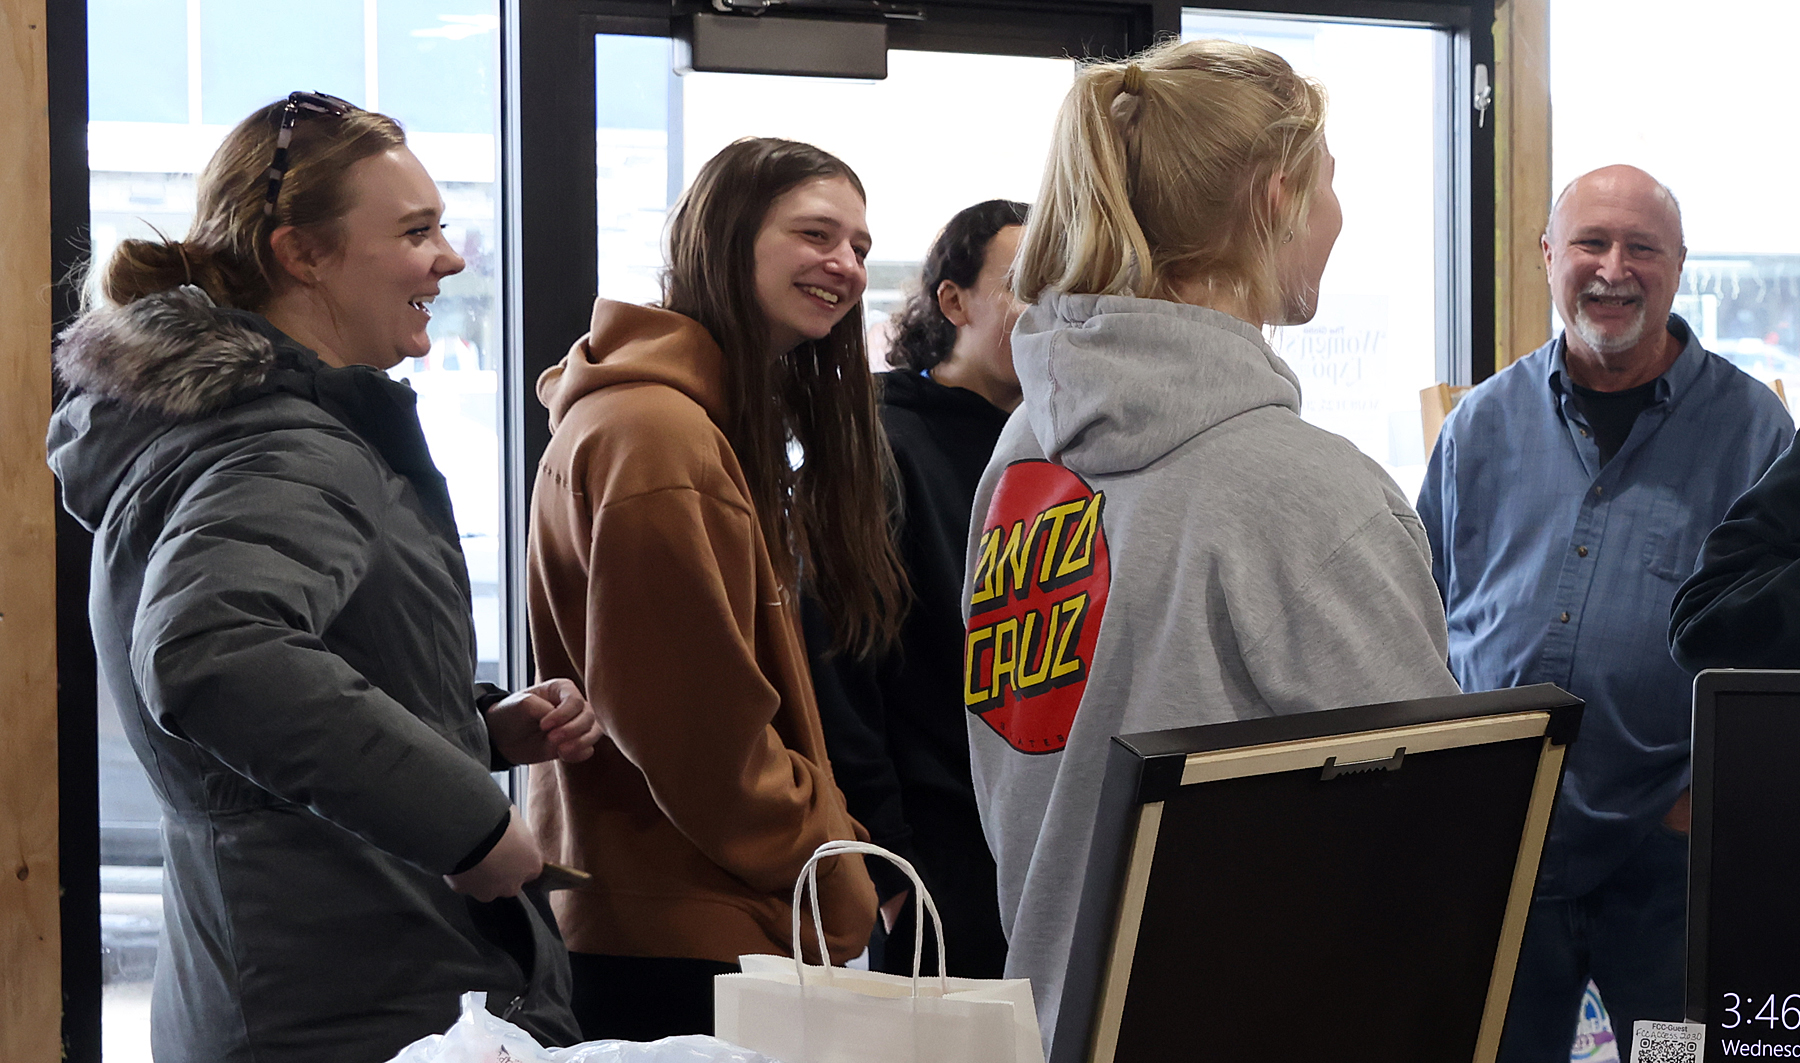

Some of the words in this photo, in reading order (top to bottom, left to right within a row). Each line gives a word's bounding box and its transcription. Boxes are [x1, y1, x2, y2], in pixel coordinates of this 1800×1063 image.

[968, 490, 1106, 612] ANTA
[964, 592, 1090, 712] CRUZ
[1651, 1022, 1688, 1033] FCC-Guest
